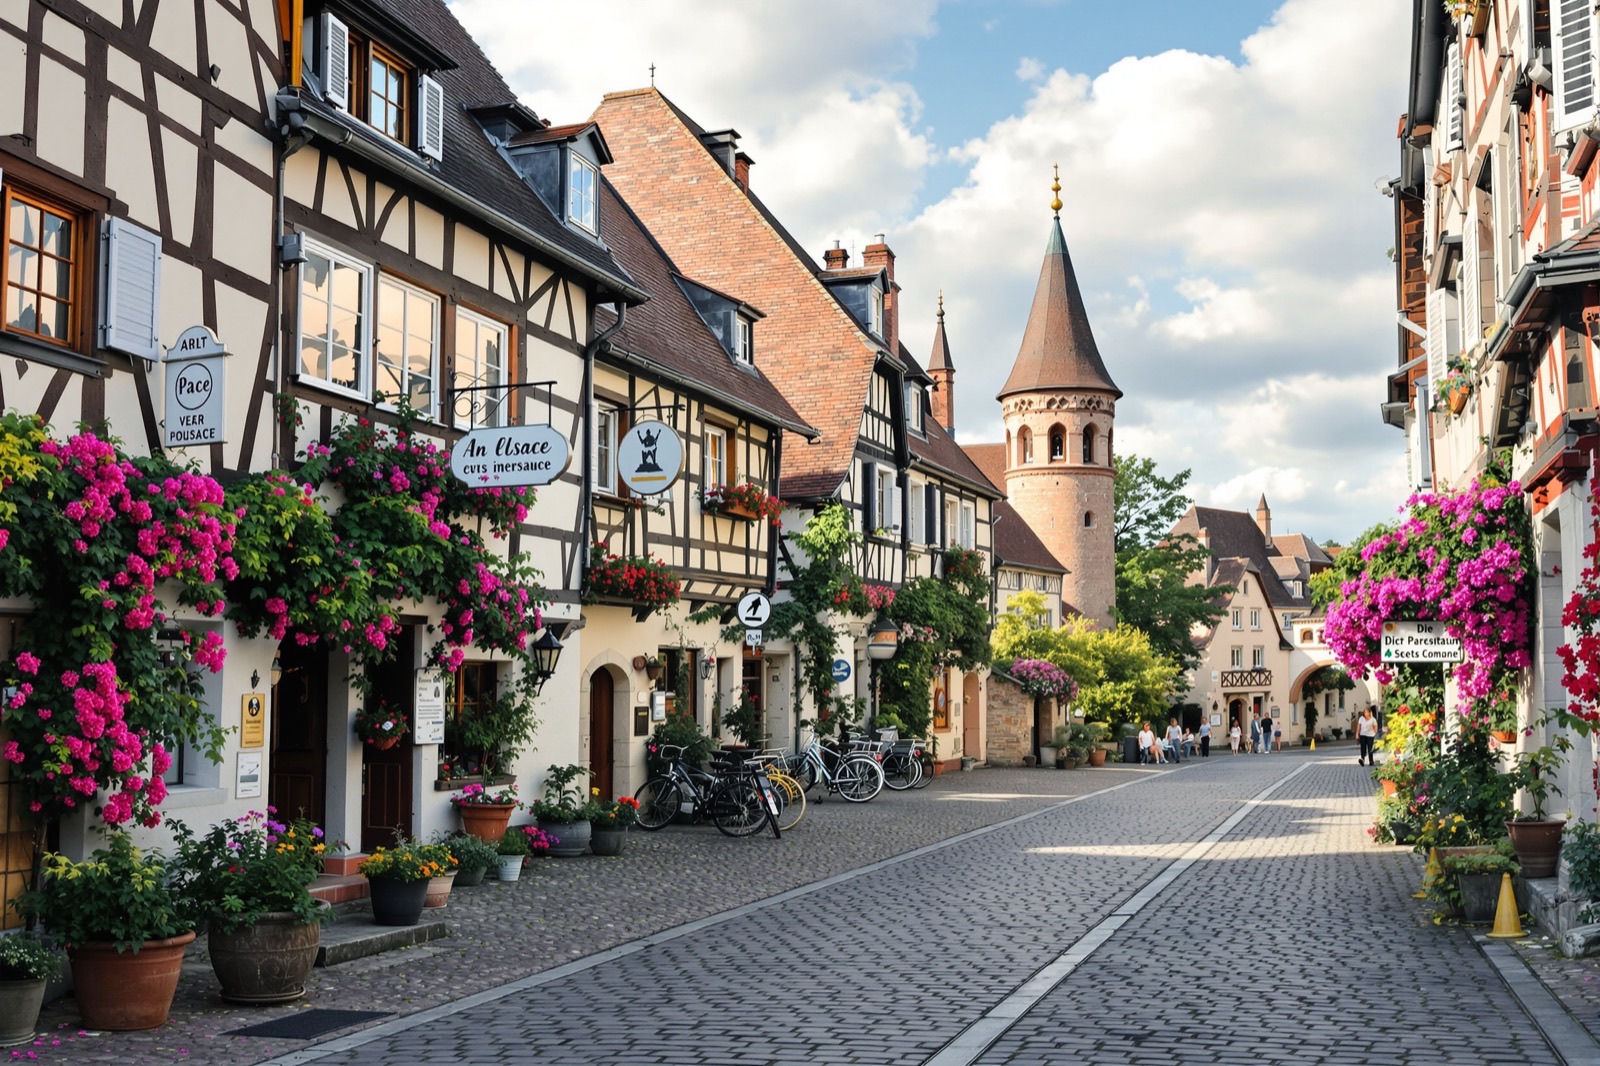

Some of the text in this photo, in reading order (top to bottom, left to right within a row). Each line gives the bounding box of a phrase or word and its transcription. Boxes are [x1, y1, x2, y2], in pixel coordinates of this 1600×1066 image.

[180, 336, 208, 351] ARLT
[179, 376, 210, 395] Pace
[170, 428, 215, 442] POUSACE
[463, 438, 487, 458] An
